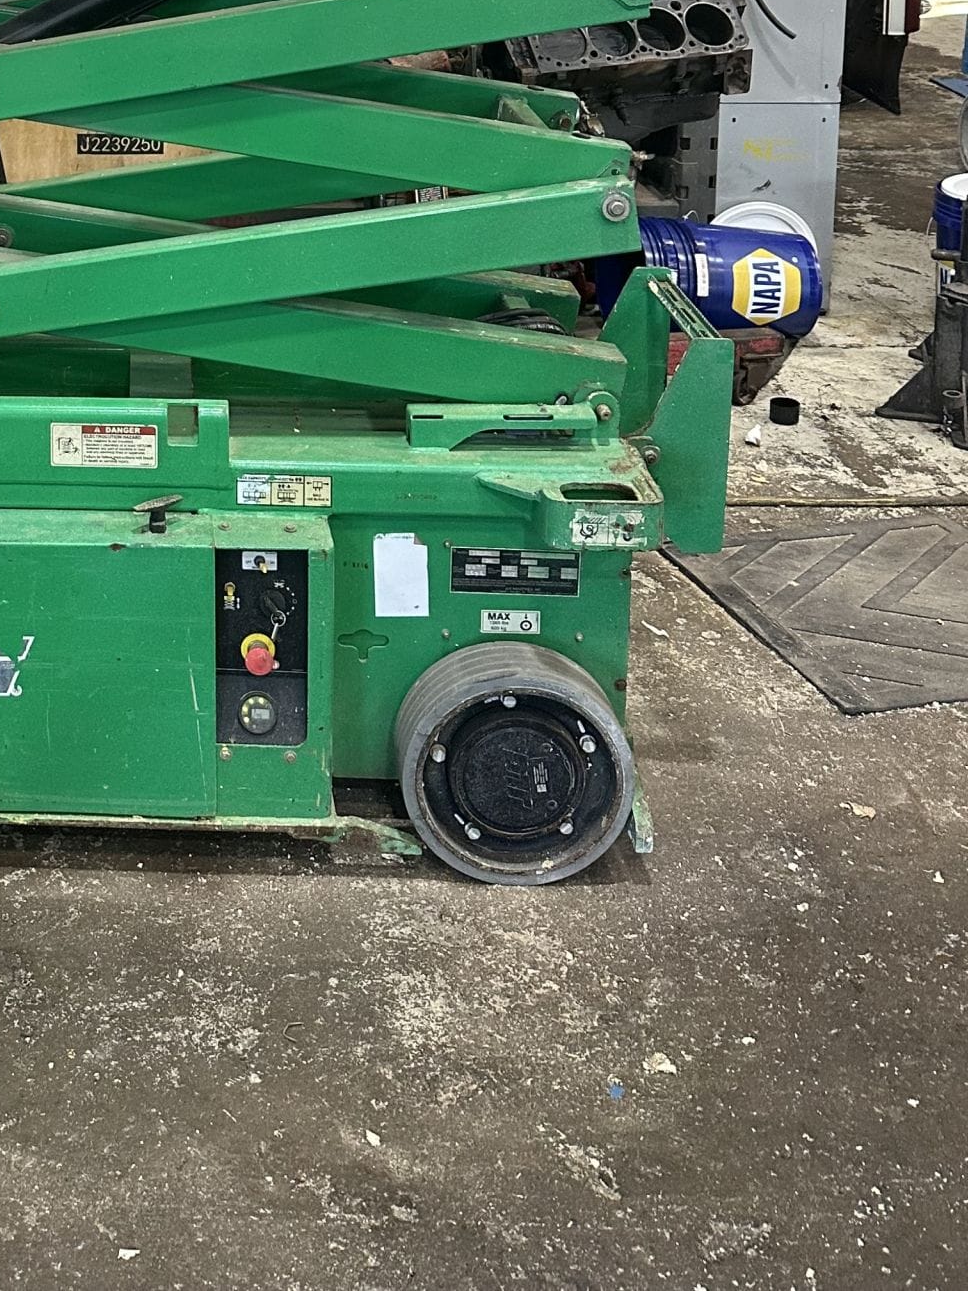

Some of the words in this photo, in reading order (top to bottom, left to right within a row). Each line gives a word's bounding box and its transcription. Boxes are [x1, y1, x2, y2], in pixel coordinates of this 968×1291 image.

[80, 136, 161, 152] J2239250
[750, 261, 782, 314] NAPA
[105, 426, 141, 434] DANGER
[487, 612, 510, 620] MAX
